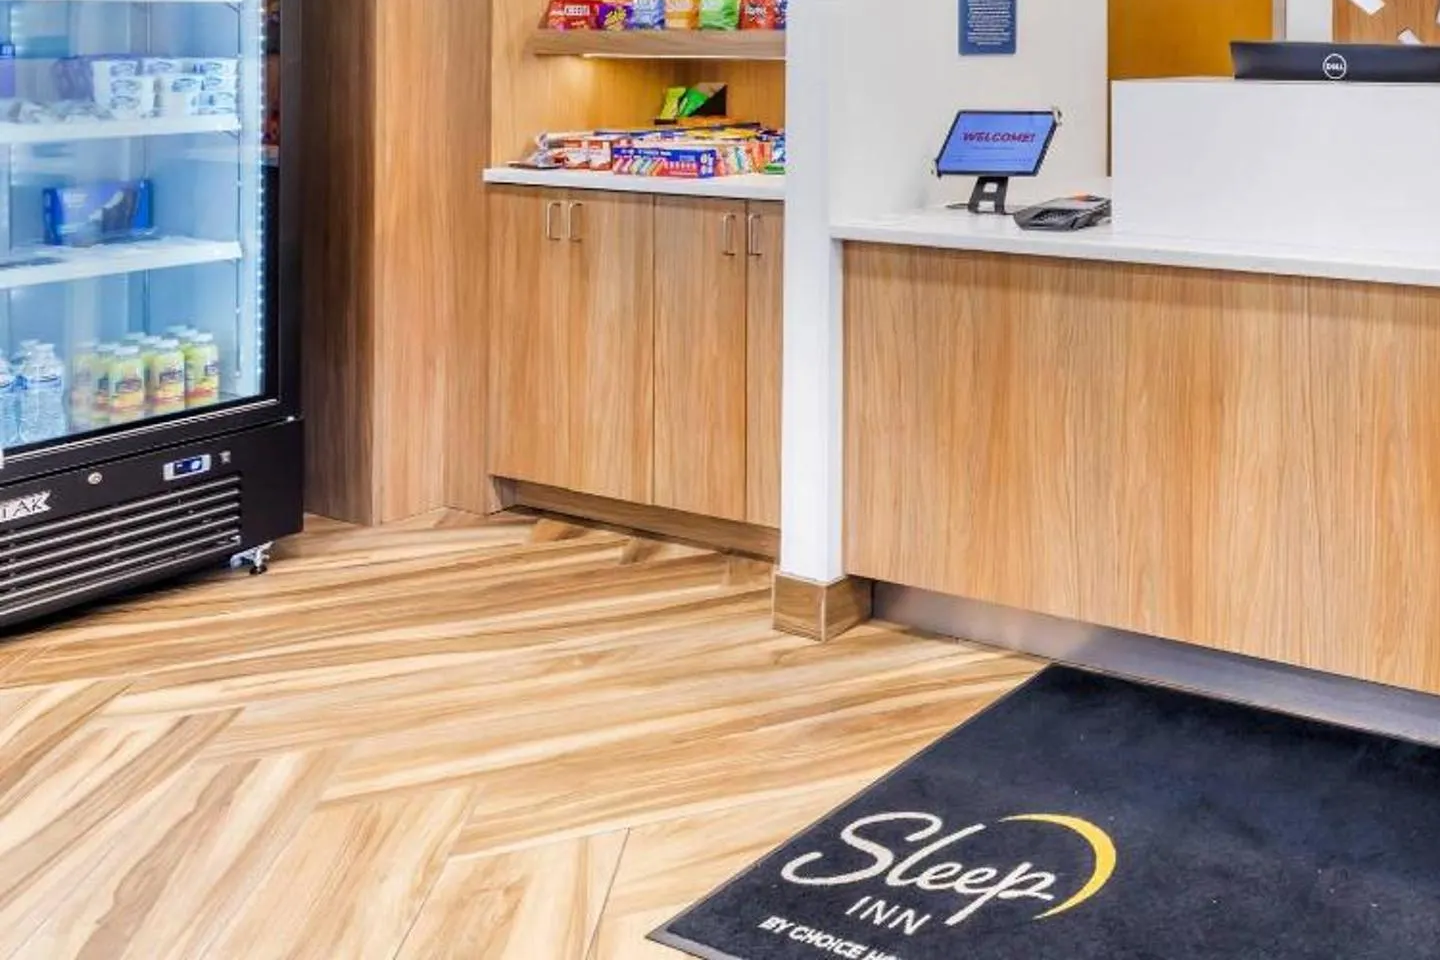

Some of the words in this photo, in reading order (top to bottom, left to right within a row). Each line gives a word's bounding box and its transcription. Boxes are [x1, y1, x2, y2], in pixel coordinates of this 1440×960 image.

[962, 131, 1035, 143] WELCOME!
[781, 811, 1056, 926] Sleep
[758, 915, 795, 934] BY
[788, 925, 869, 959] CHOICE
[845, 896, 932, 936] INN
